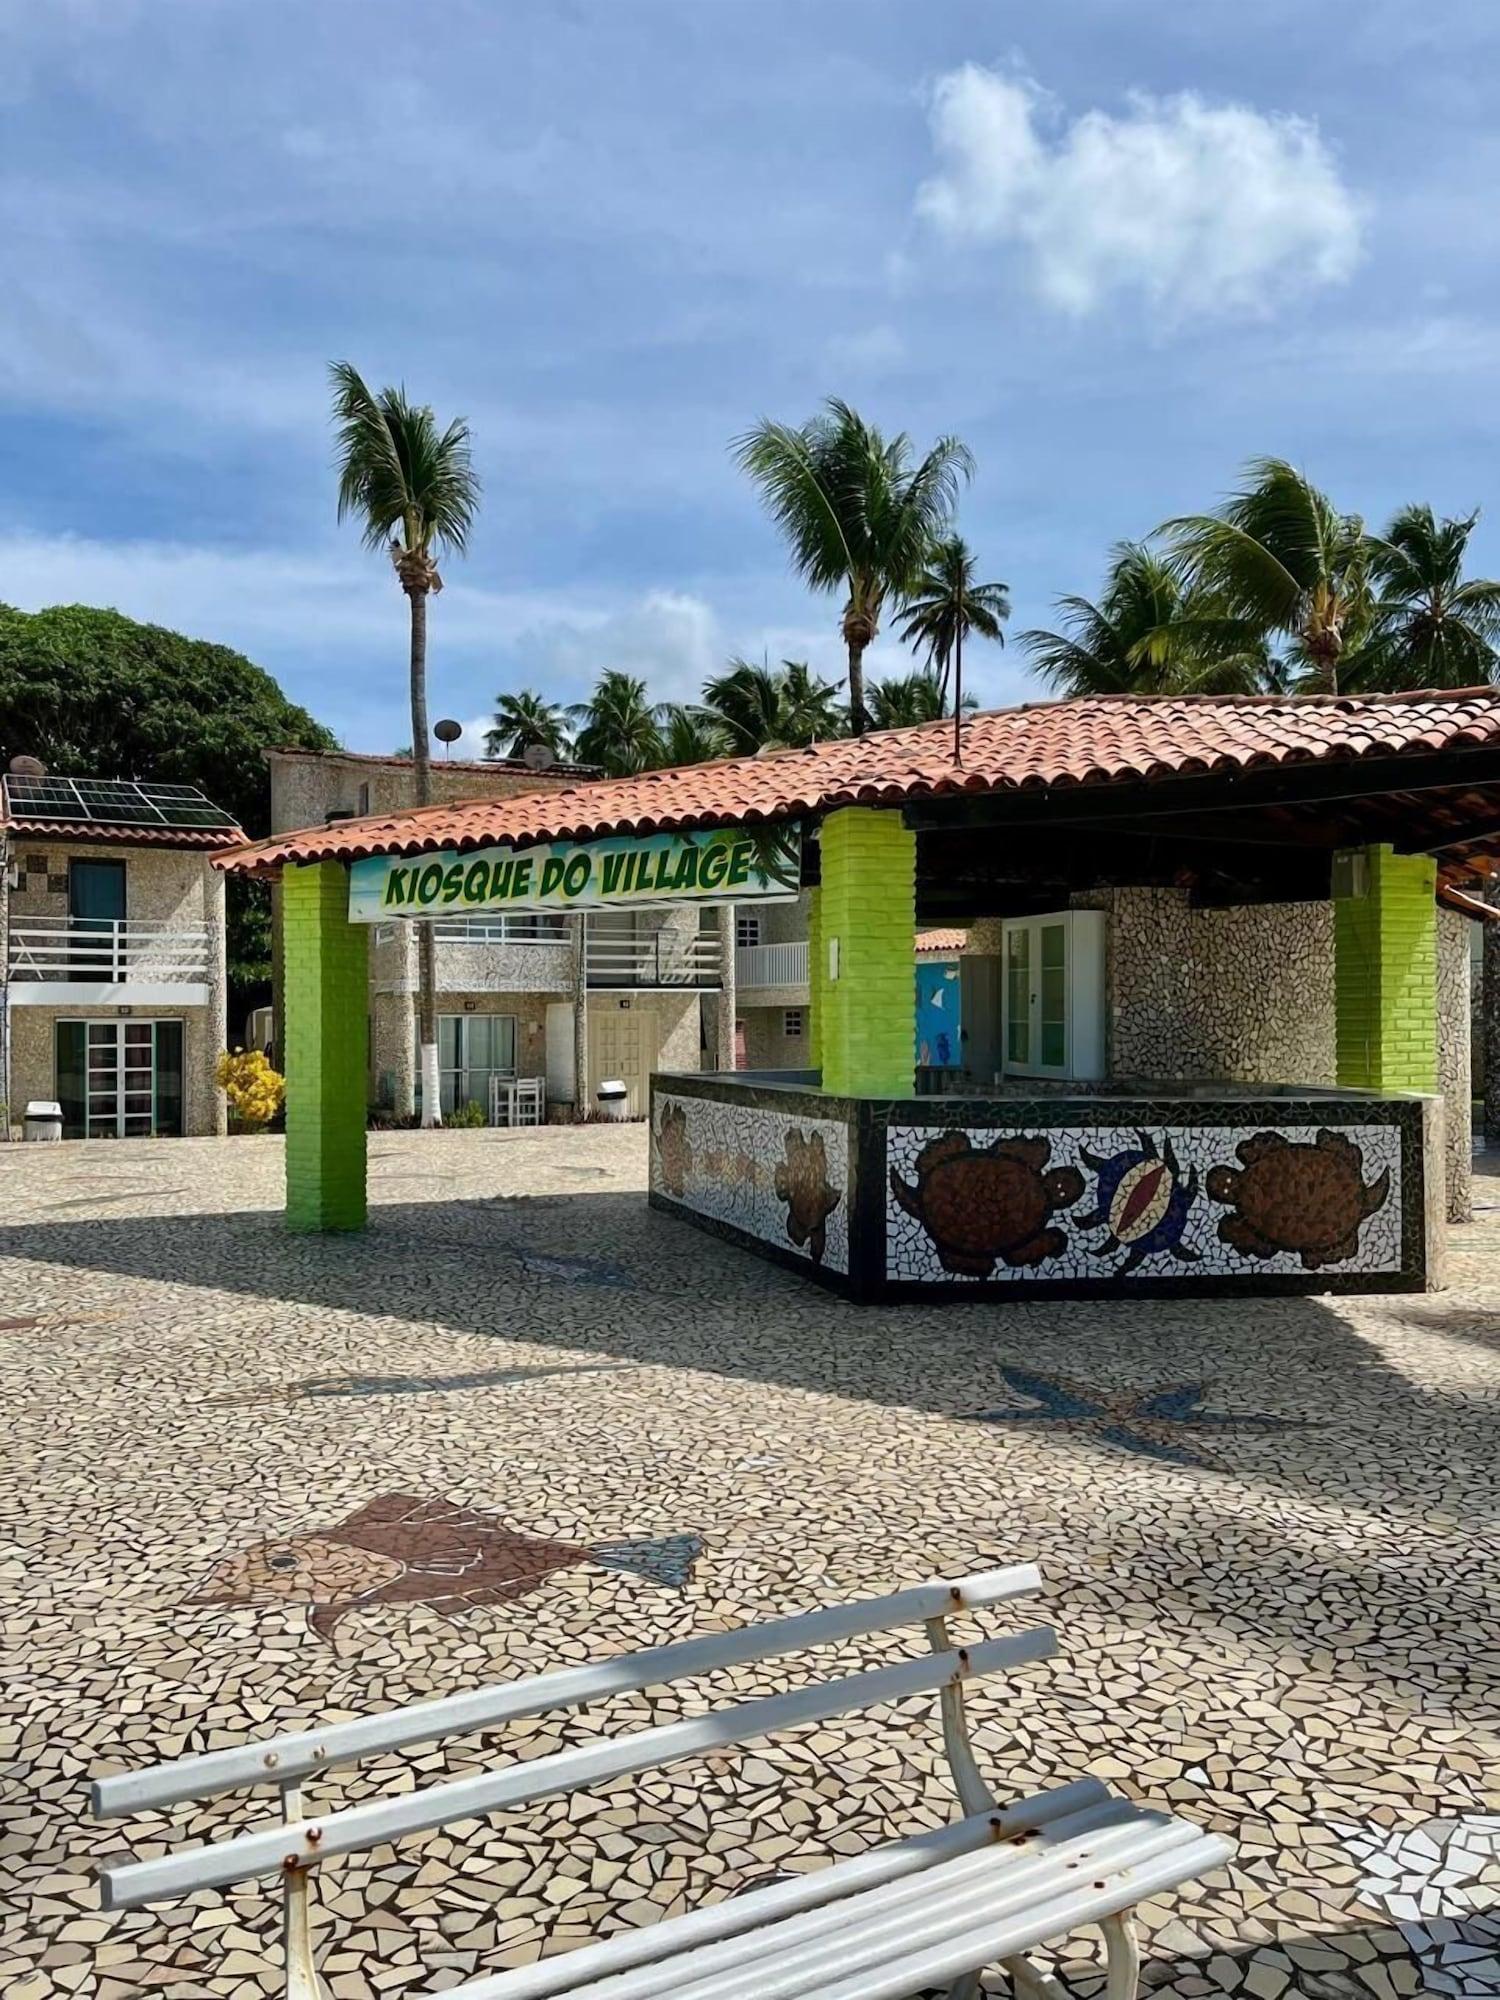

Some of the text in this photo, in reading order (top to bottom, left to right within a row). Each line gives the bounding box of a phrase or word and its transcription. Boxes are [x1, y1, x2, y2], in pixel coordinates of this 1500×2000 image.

[385, 841, 753, 904] KIOSQUE DO VILLAGE
